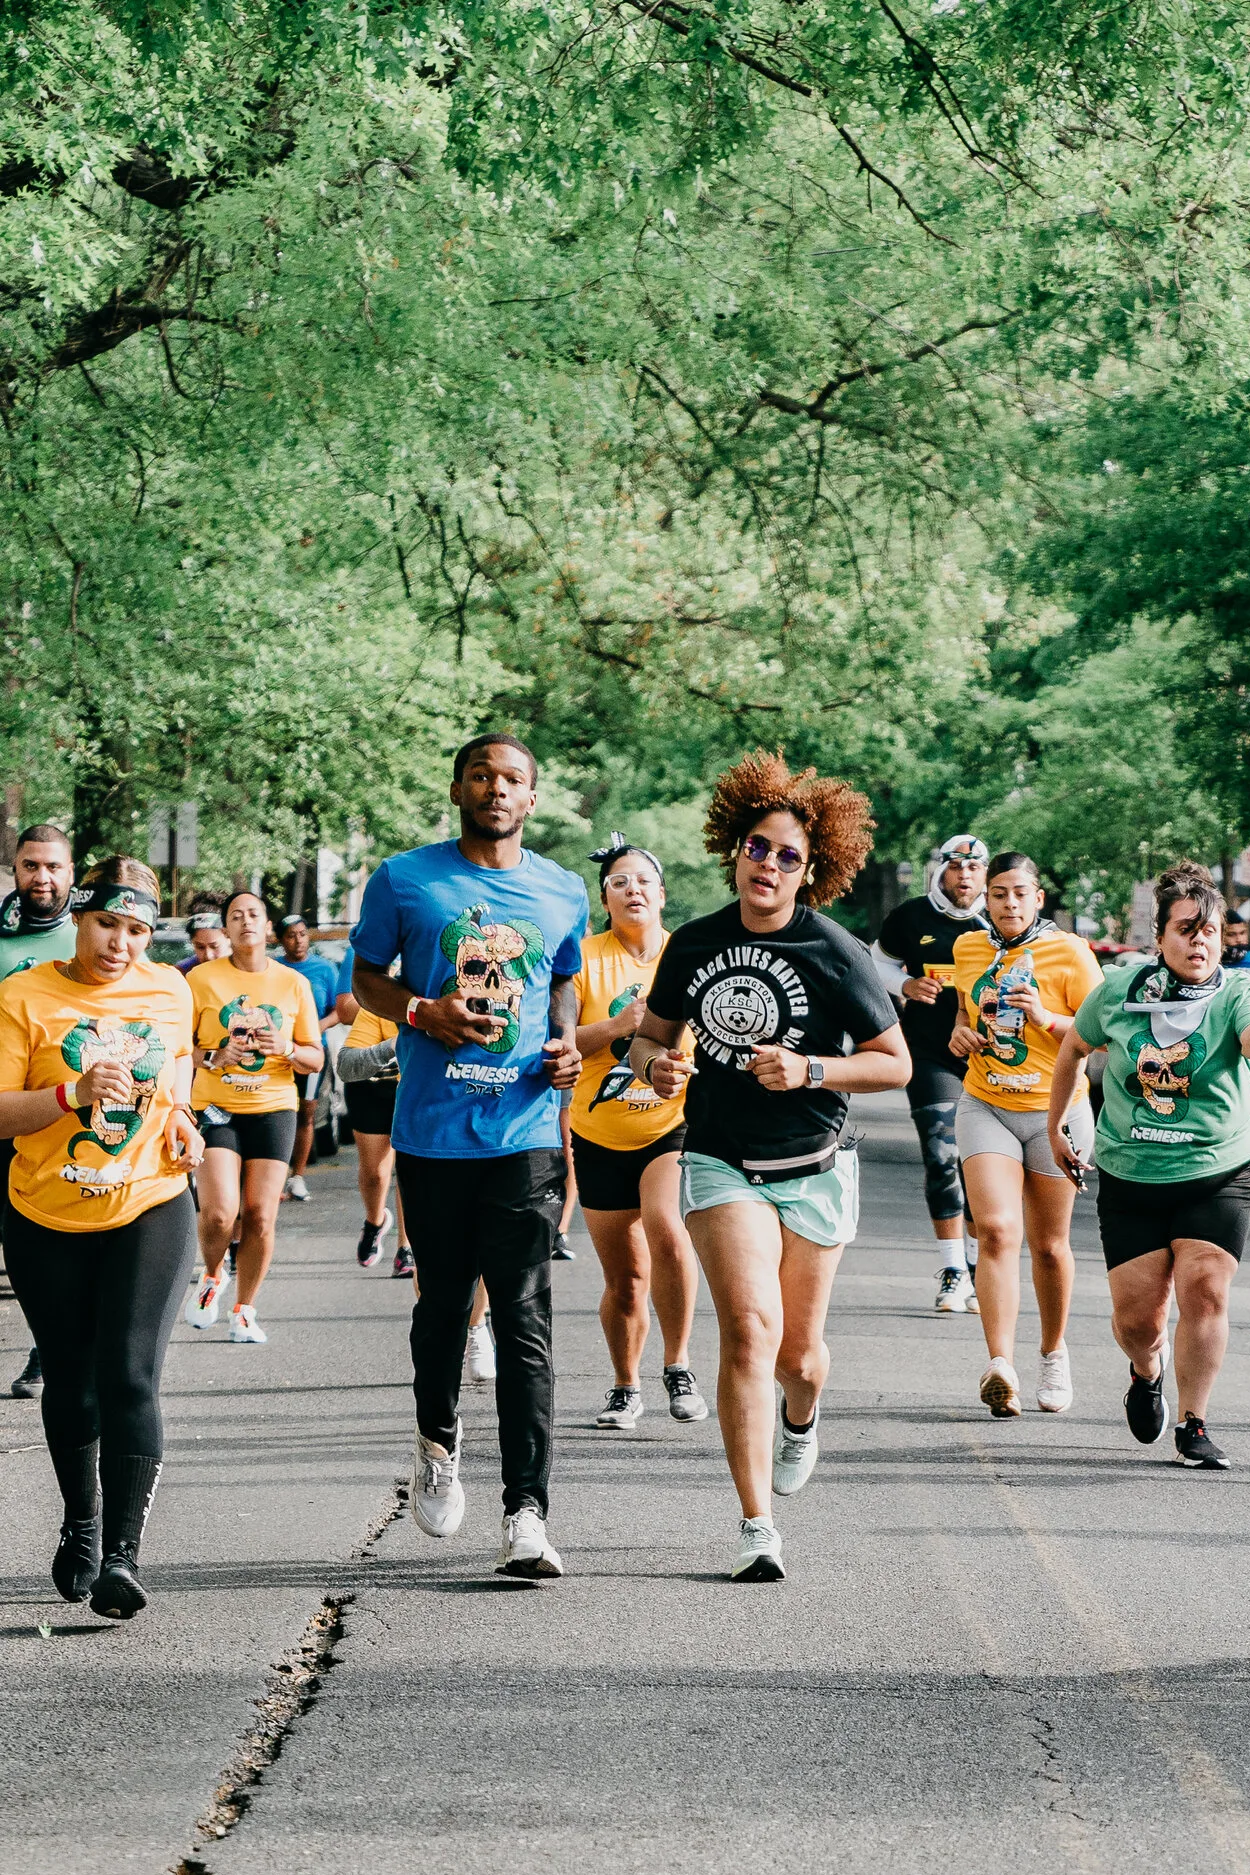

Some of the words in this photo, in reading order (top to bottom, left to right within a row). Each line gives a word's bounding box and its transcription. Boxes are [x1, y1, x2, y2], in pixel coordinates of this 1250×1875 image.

[686, 953, 727, 997] BLACK
[727, 946, 772, 971] LIVES
[768, 958, 809, 1016] MATTER
[710, 978, 774, 1004] KENSINGTON
[728, 997, 753, 1008] KSC
[711, 1026, 747, 1045] SOCCER
[445, 1062, 519, 1083] NEMESIS
[1130, 1126, 1195, 1144] NEMESIS
